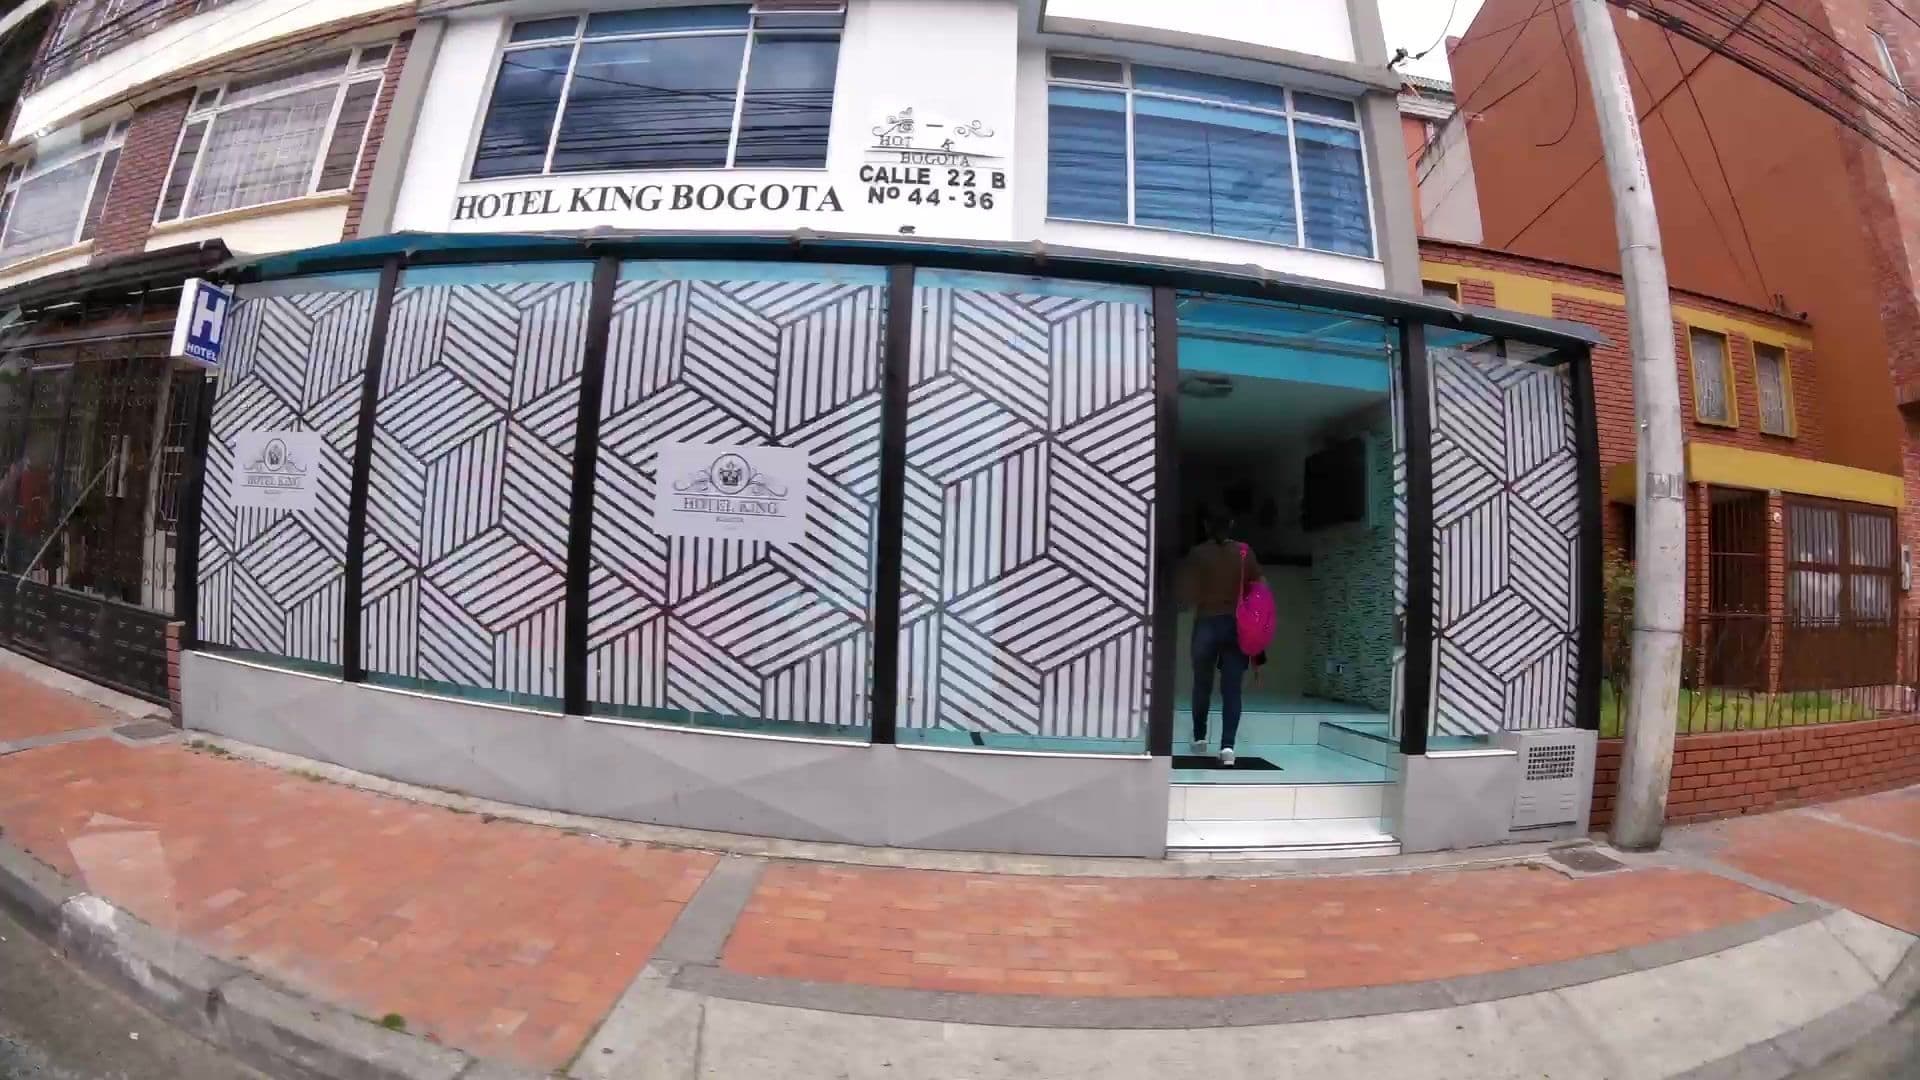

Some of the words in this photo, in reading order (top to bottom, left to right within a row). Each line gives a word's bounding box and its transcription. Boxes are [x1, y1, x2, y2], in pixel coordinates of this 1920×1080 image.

[900, 152, 970, 167] BOGOTA
[859, 165, 931, 185] CALLE
[947, 169, 976, 187] 22
[992, 172, 1006, 189] B
[452, 190, 562, 221] HOTEL
[568, 185, 664, 212] KING
[669, 183, 845, 212] BOGOTA
[192, 291, 226, 344] H
[187, 344, 217, 361] HOTEL
[683, 497, 736, 513] HOTEL
